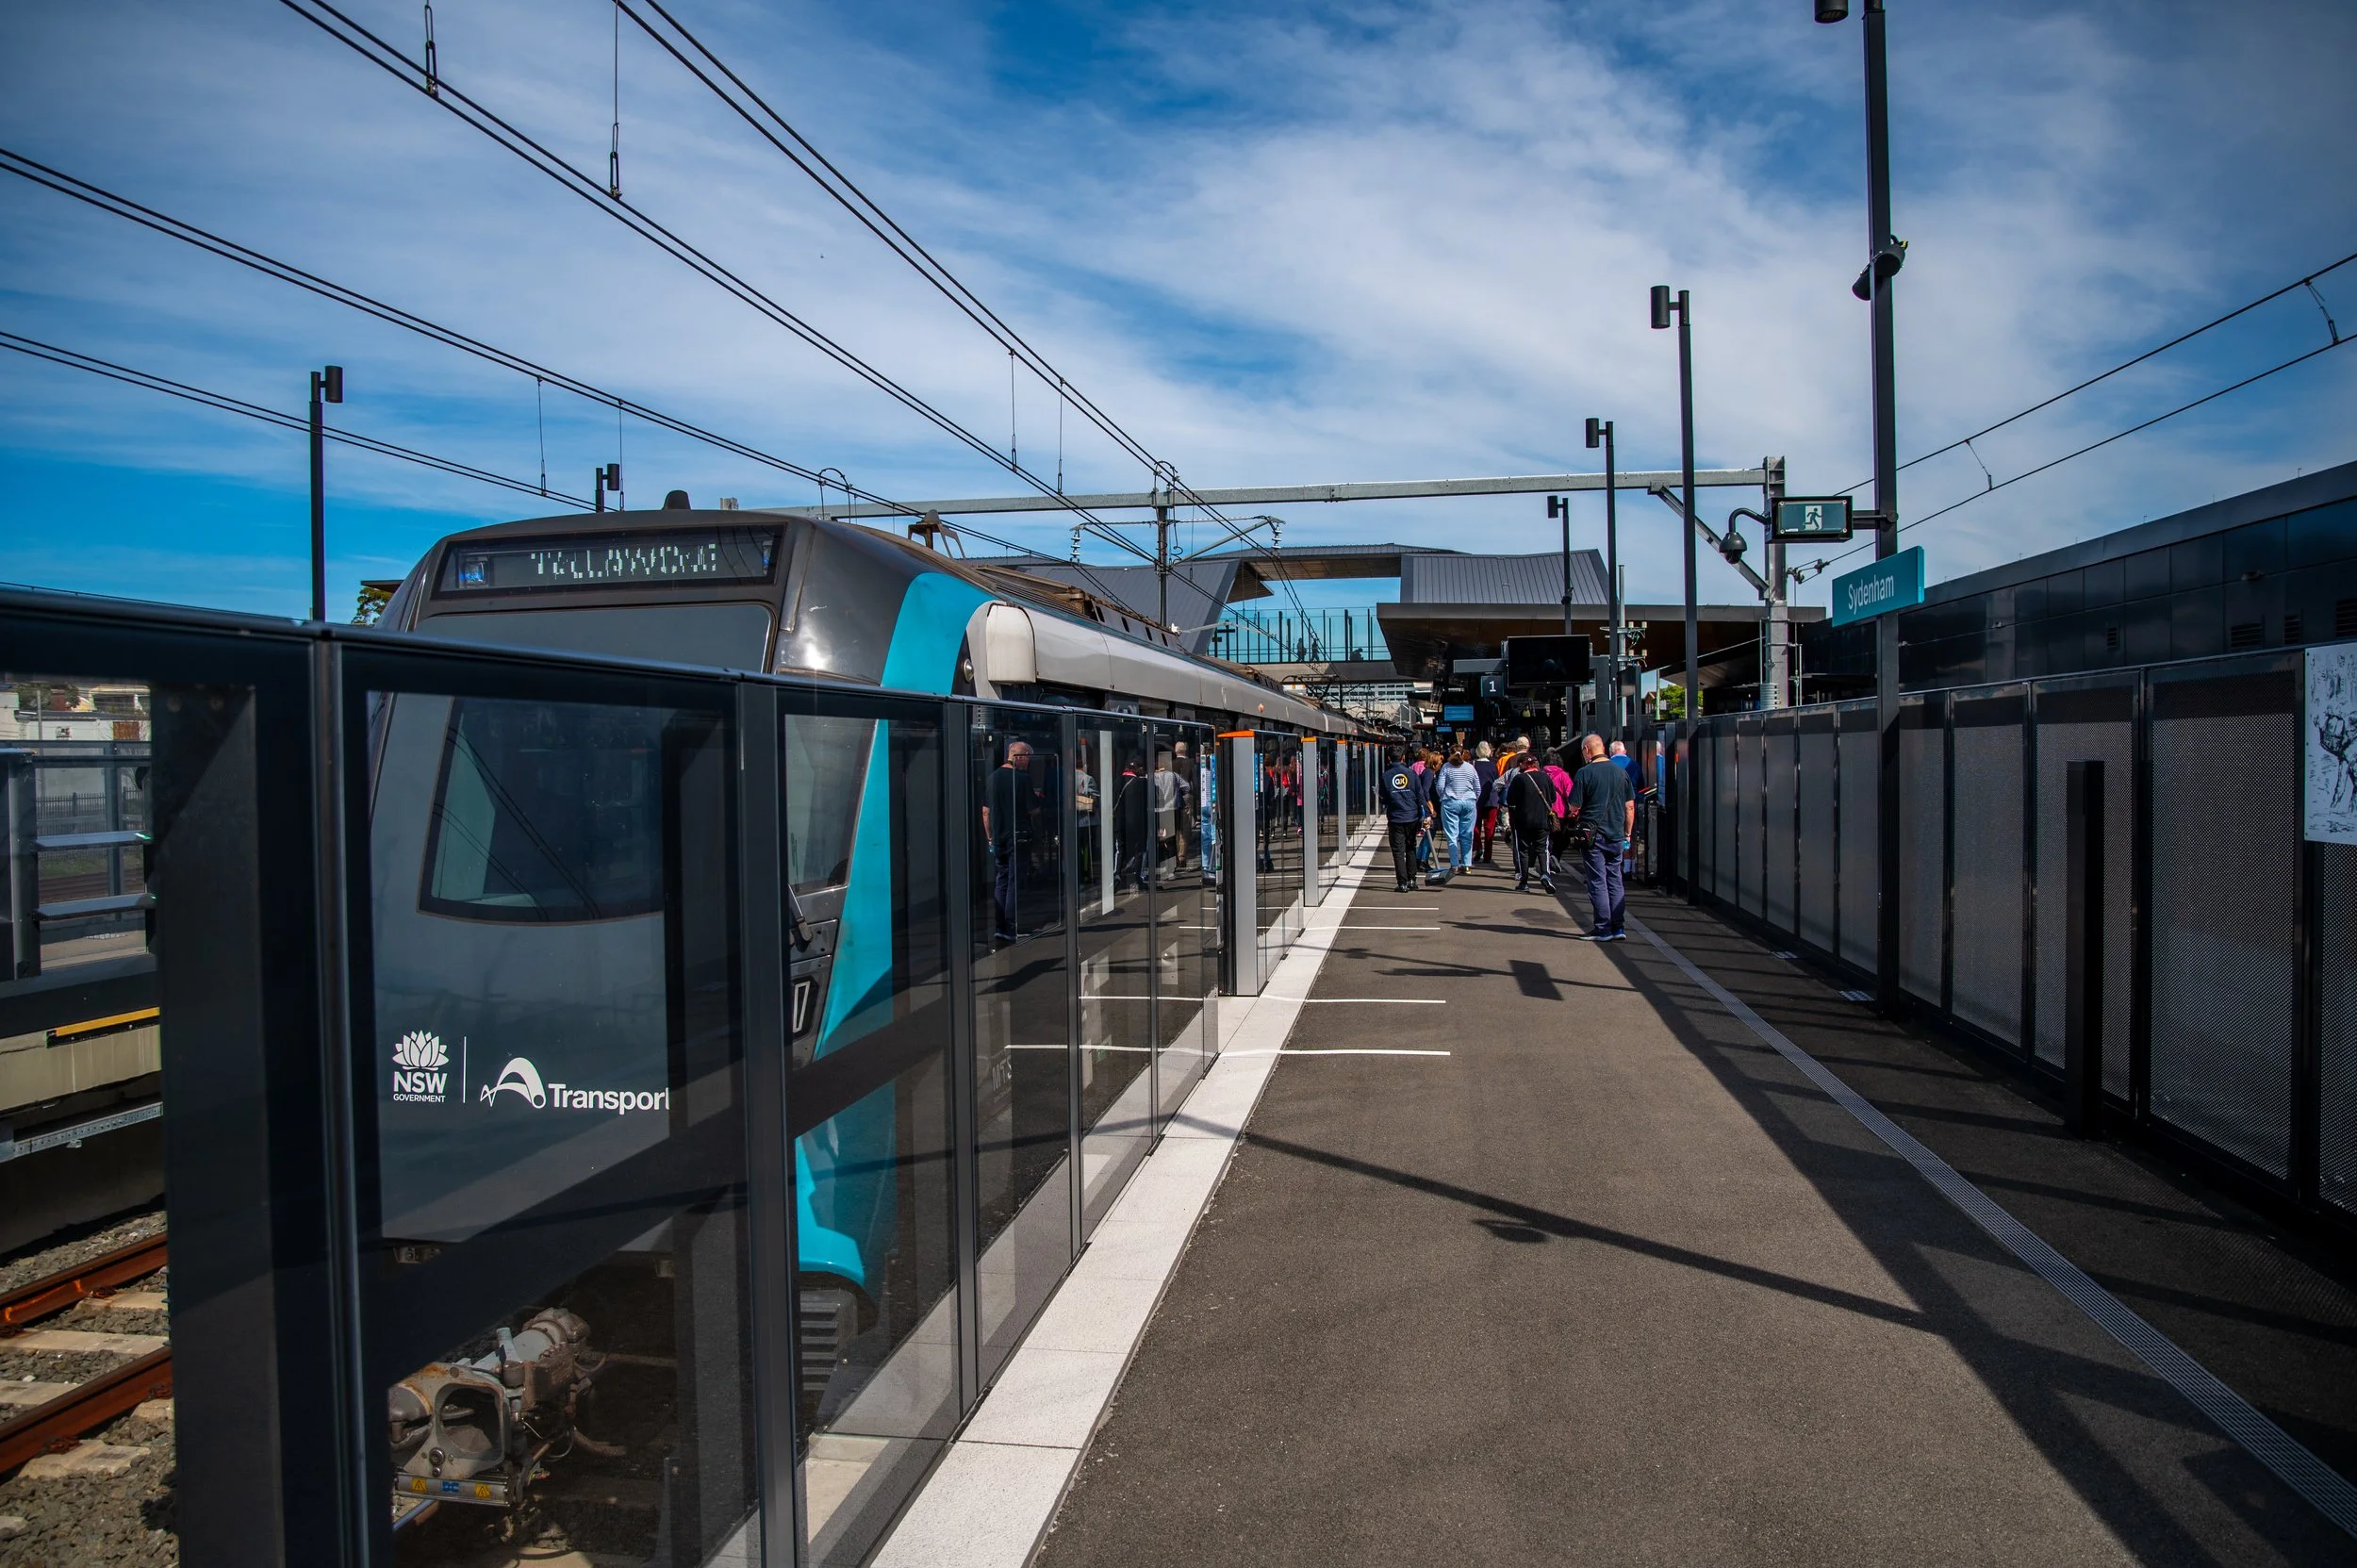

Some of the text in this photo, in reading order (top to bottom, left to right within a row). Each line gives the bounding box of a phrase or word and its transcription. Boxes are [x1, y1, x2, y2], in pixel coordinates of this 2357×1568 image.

[1848, 574, 1895, 615] Sydenham
[1489, 680, 1496, 692] 1
[393, 1071, 447, 1095] NSW
[393, 1094, 446, 1103] GOVERNMENT
